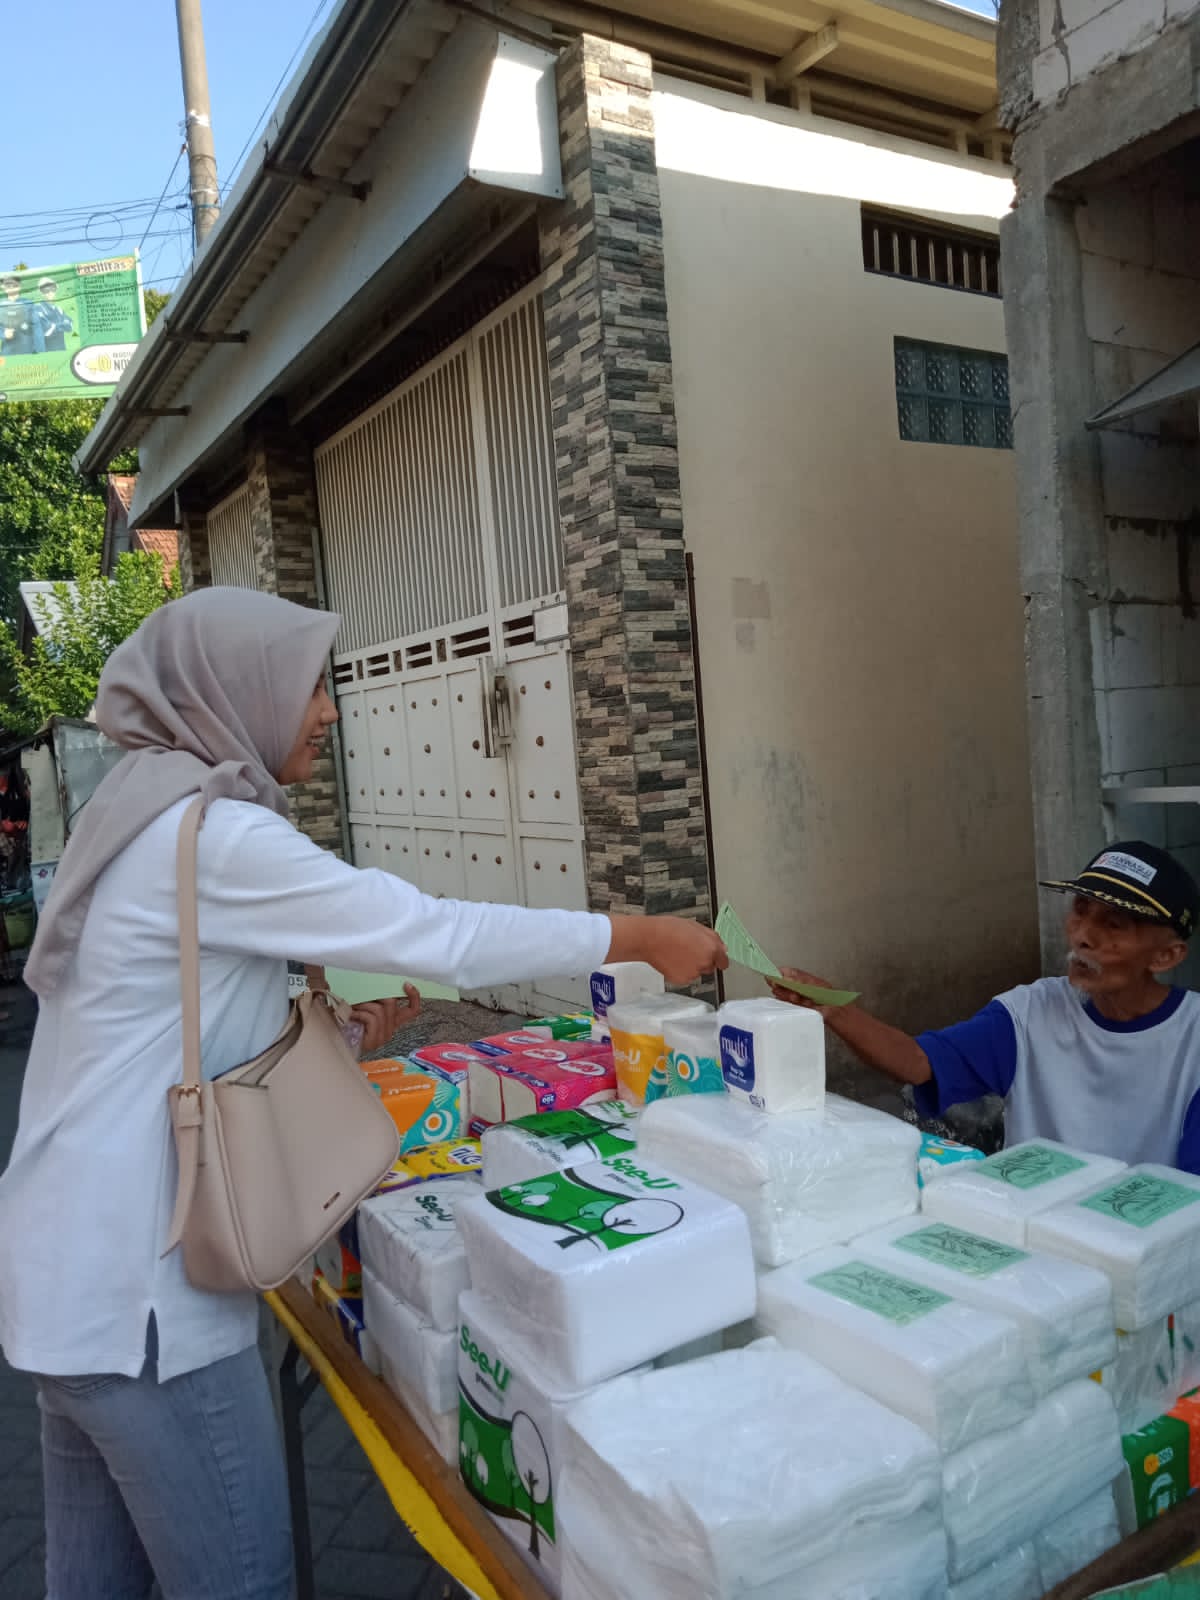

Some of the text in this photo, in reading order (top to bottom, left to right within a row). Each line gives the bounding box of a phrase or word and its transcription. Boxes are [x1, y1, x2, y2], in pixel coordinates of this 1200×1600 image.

[721, 1034, 749, 1060] multi
[601, 1158, 679, 1189] See-U
[460, 1325, 511, 1392] See-U
